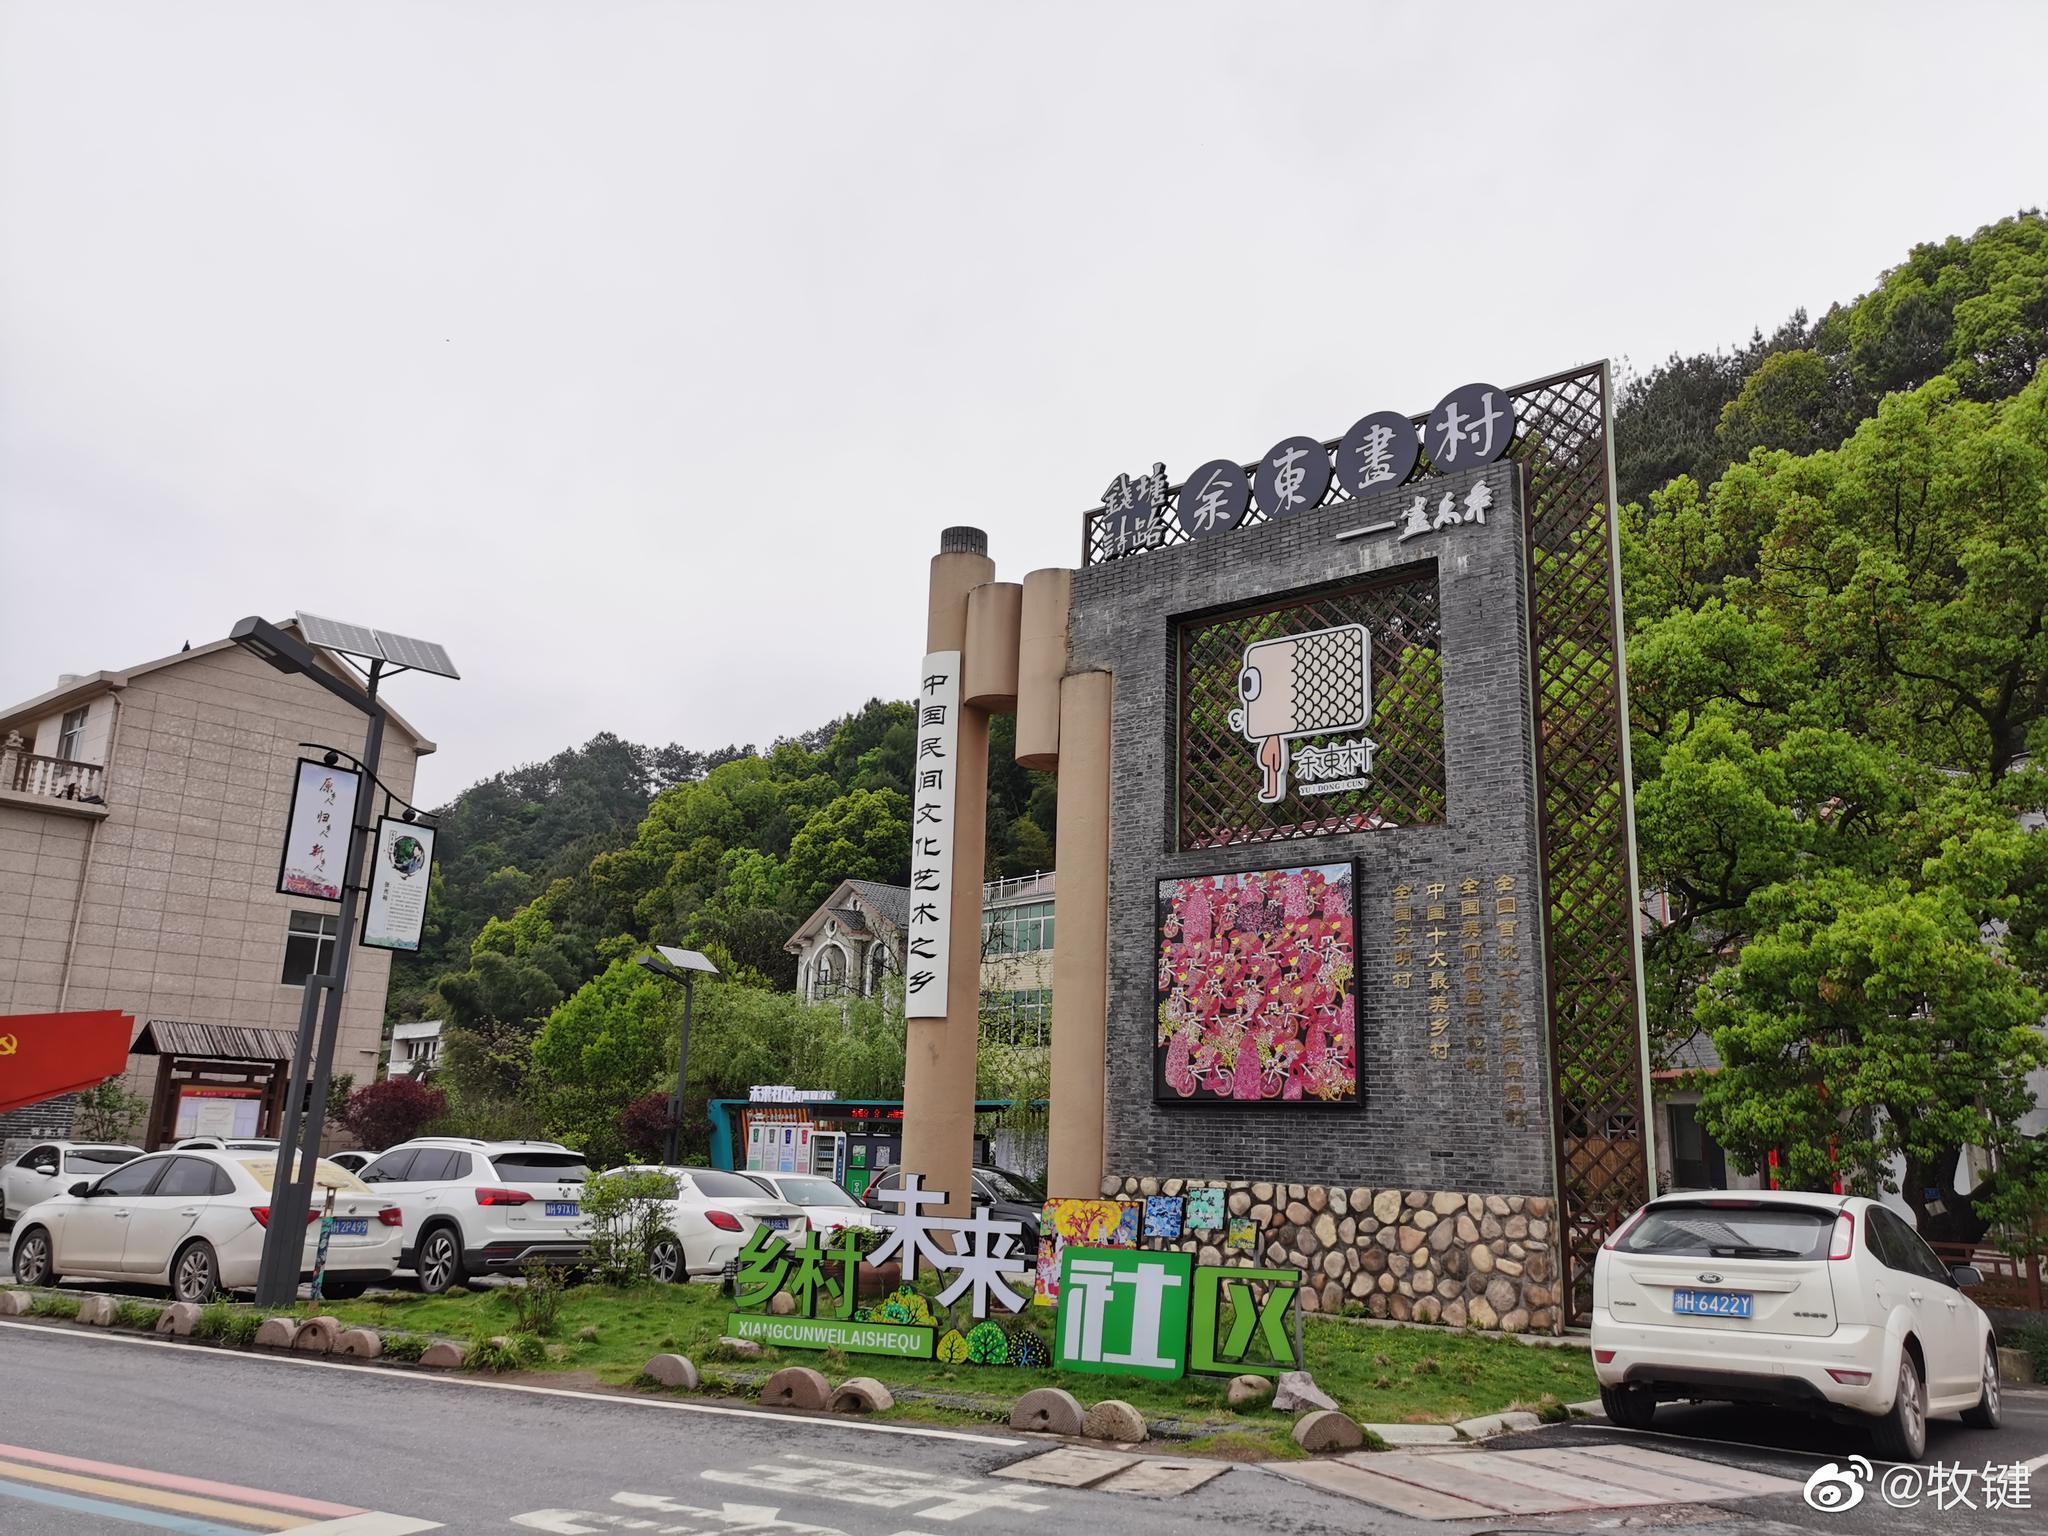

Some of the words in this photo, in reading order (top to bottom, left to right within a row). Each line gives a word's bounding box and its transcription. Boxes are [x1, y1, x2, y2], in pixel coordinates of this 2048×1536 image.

[909, 673, 949, 994] 中国民间文化艺术之乡
[1318, 782, 1341, 792] DONG
[1346, 780, 1364, 788] CUN
[1392, 883, 1414, 989] 全国文明村
[1426, 882, 1451, 1060] 中国十大最美乡村
[738, 1321, 921, 1352] XIANGCUNWEILAISHEQU
